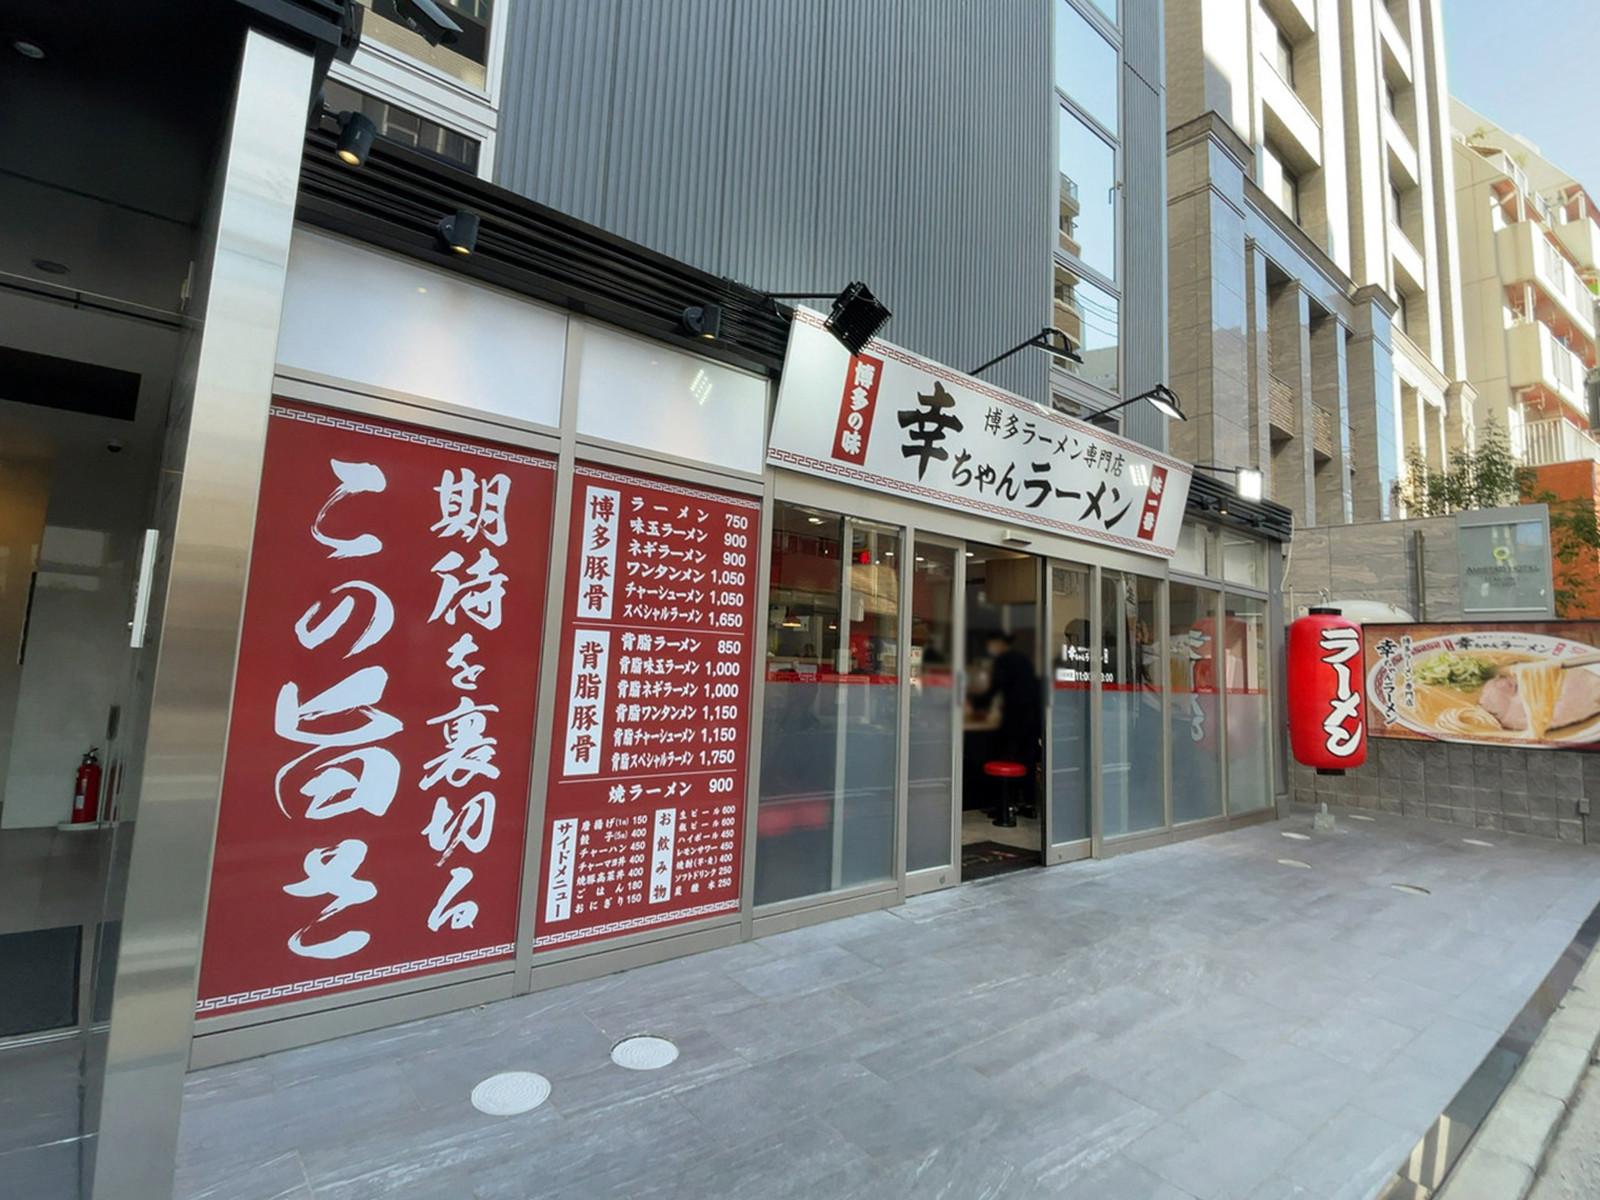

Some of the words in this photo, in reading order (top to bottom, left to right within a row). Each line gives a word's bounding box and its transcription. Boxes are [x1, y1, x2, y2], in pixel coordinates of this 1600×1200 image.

[841, 360, 874, 457] 博多の味
[984, 407, 1126, 477] 博多ラーメン専門店
[897, 381, 1133, 530] 幸ちゃんラーメン
[631, 497, 709, 522] ラーメン
[725, 514, 748, 530] 750
[1141, 475, 1162, 532] 味一番
[630, 518, 708, 543] 味玉ラーメン
[724, 534, 747, 549] 900
[584, 495, 615, 613] 博多豚骨
[628, 539, 707, 563] ネギラーメン
[723, 553, 746, 568] 900
[627, 561, 705, 583] ワンタンメン
[711, 569, 745, 586] 1,050
[625, 582, 704, 604] チャーシューメン
[709, 590, 744, 607] 1,050
[623, 603, 703, 623] スペシャルラーメン
[708, 612, 743, 628] 1,650
[621, 632, 701, 653] 背脂ラーメン
[717, 640, 741, 655] 850
[619, 656, 700, 675] 背脂味玉ラーメン
[705, 662, 740, 677] 1,000
[617, 679, 699, 699] 背脂ネギラーメン
[704, 683, 739, 698] 1,000
[1319, 626, 1363, 757] ラーメン
[1376, 639, 1398, 725] 幸ちゃんラーメン
[274, 458, 404, 960] この旨さ
[419, 467, 511, 932] 期待を裏切る
[571, 641, 604, 764] 背脂豚骨
[615, 704, 697, 723] 背脂ワンタンメン
[702, 706, 738, 721] 1,150
[613, 727, 696, 747] 背脂チャーシューメン
[701, 727, 736, 744] 1,150
[611, 750, 694, 772] 背脂スペシャルラーメン
[699, 749, 735, 766] 1,750
[608, 781, 692, 804] 焼ラーメン
[709, 777, 734, 793] 900
[632, 815, 648, 825] 150
[679, 808, 720, 820] 生ビール
[631, 828, 647, 838] 400
[678, 832, 719, 843] ハイボール
[579, 844, 627, 858] チャーハン
[630, 841, 646, 851] 450
[629, 854, 645, 864] 400
[653, 813, 672, 900] お飲み物
[677, 845, 718, 856] レモンサワー
[719, 853, 733, 863] 400
[553, 822, 572, 918] サイドメニュー
[628, 867, 644, 877] 400
[675, 868, 717, 882] ソフトドリンク
[718, 865, 732, 875] 250
[577, 883, 624, 899] ごはん
[627, 880, 643, 890] 180
[718, 878, 732, 887] 250
[575, 896, 624, 913] おにぎり
[626, 893, 642, 904] 150
